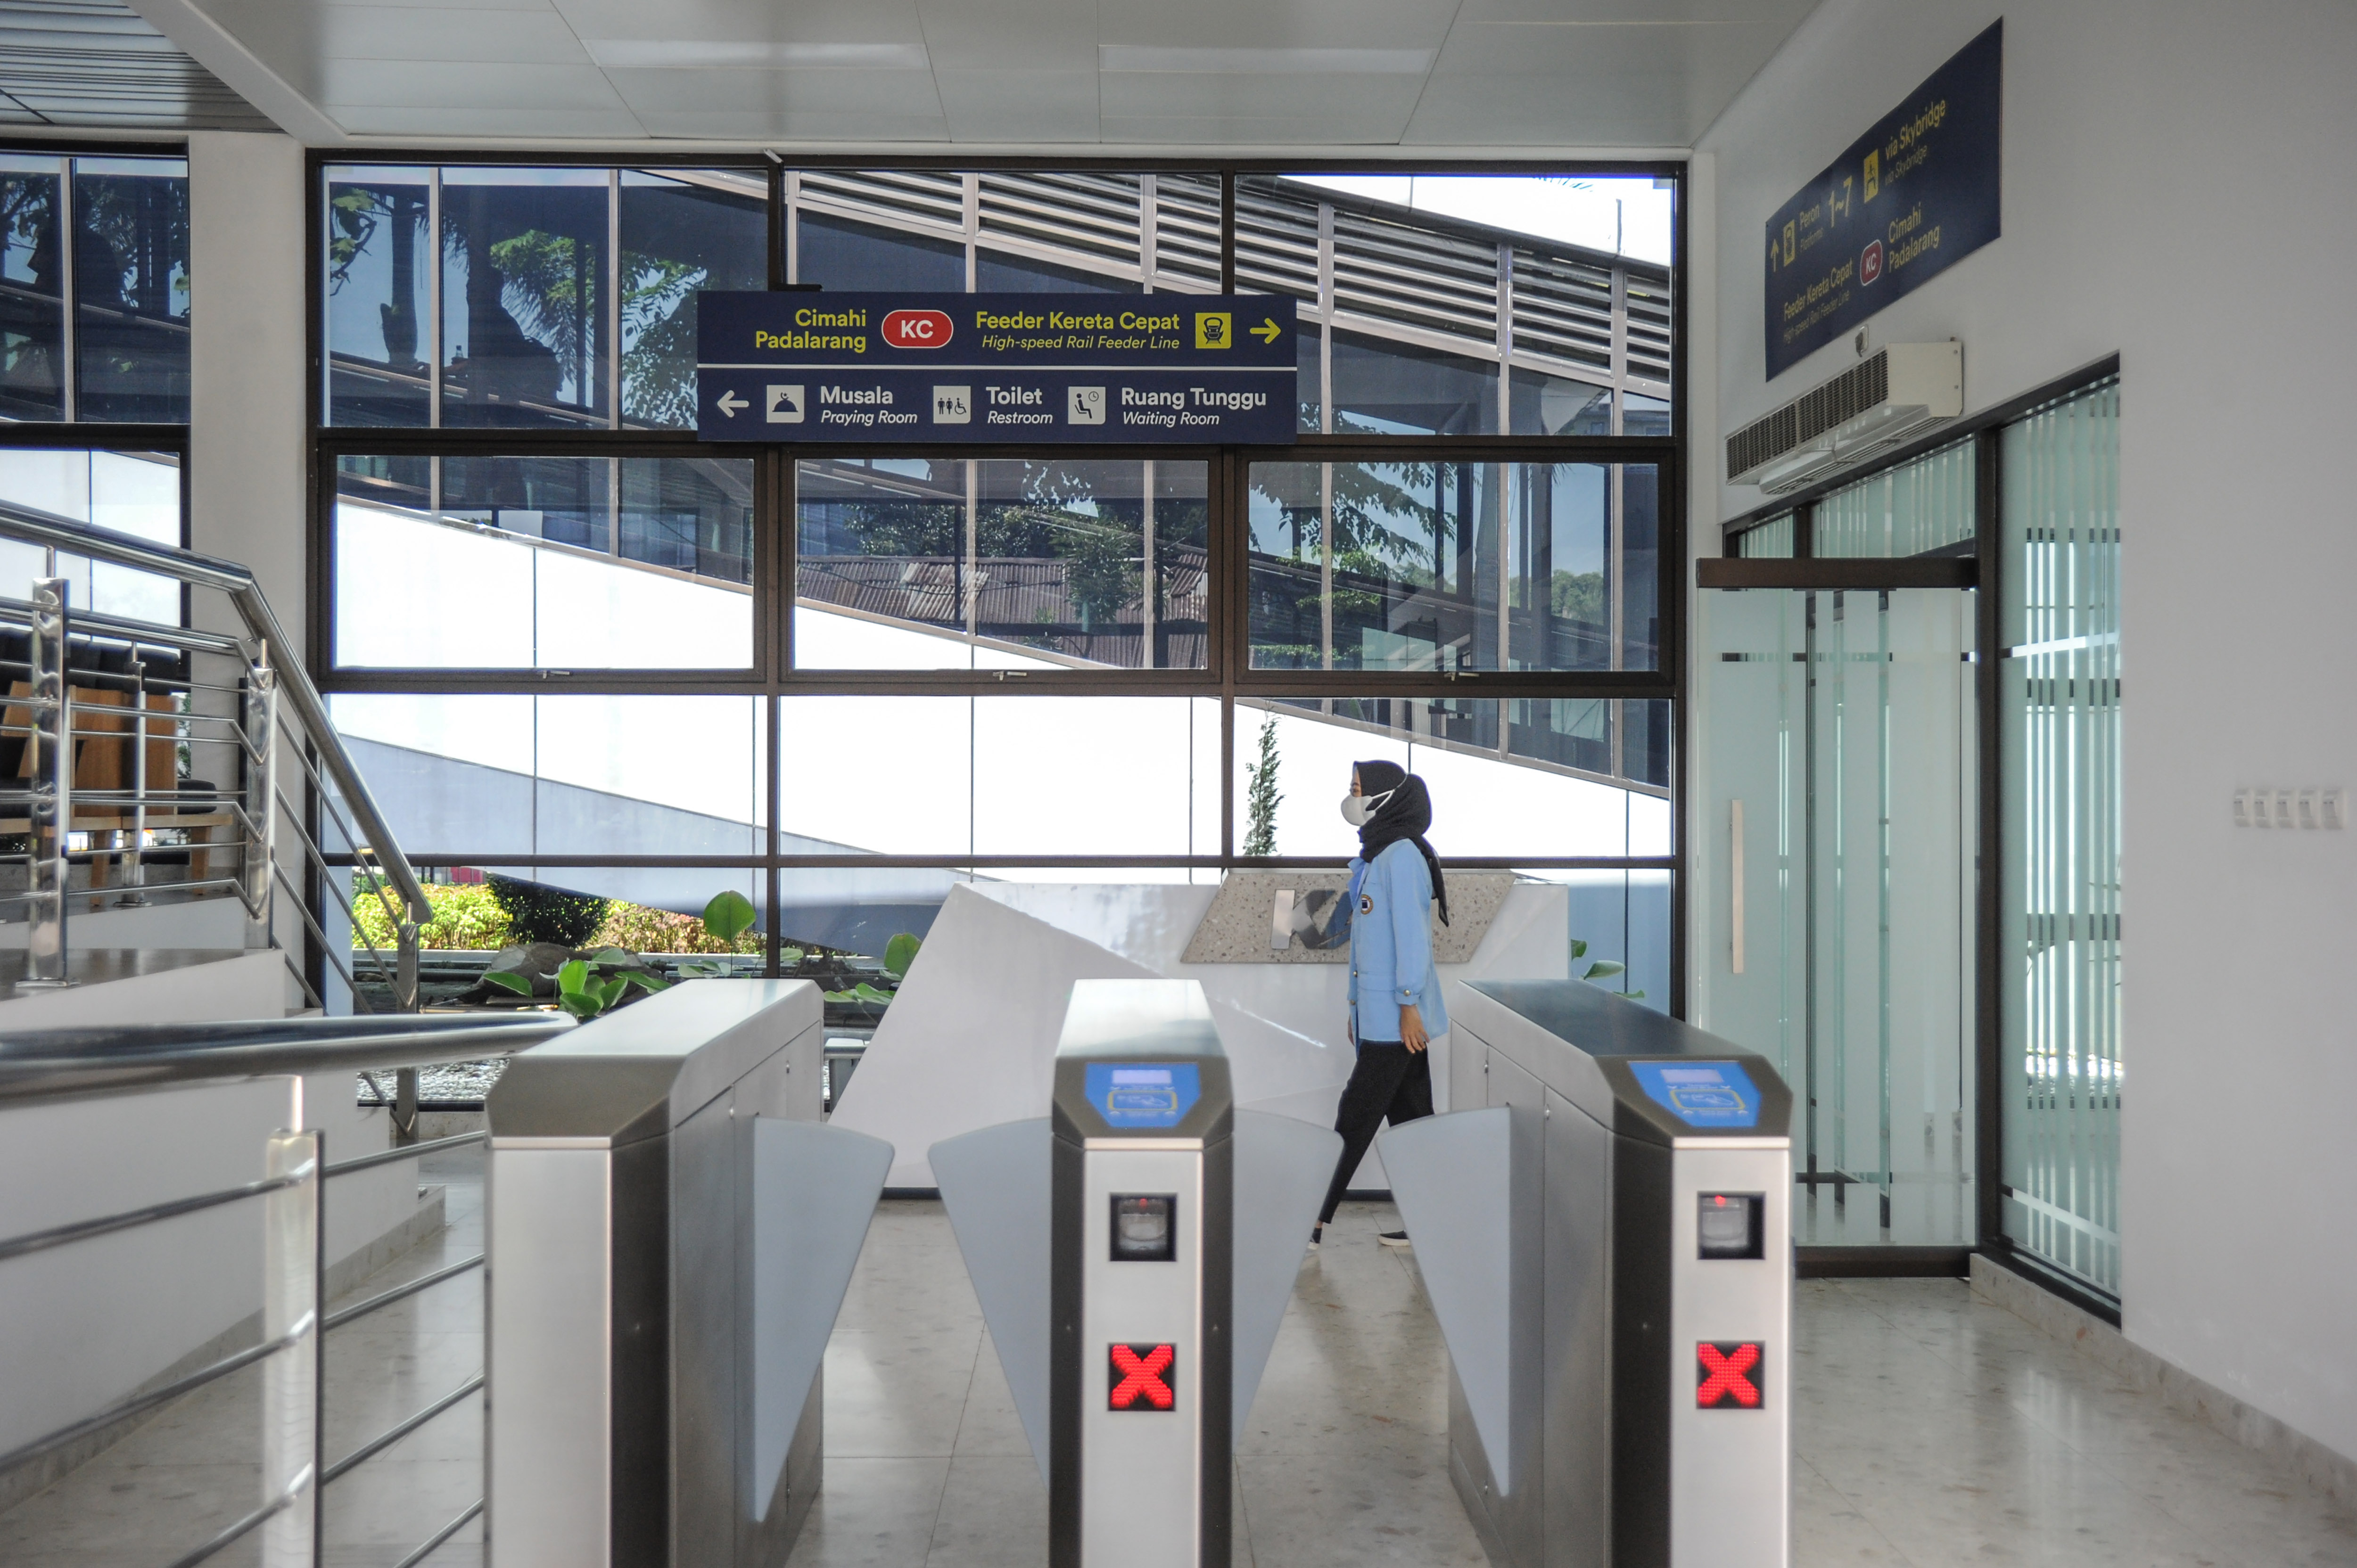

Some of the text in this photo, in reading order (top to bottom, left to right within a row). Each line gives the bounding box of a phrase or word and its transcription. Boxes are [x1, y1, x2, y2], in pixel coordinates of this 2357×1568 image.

[1886, 99, 1945, 160] via Skybridge
[1895, 145, 1927, 178] Skybridge
[1800, 204, 1820, 231] Peron
[1889, 201, 1921, 243] Cimahi
[1889, 225, 1940, 273] Padalarang
[1866, 253, 1876, 274] KC
[1784, 257, 1852, 322] Feeder Kereta Cepat
[796, 309, 866, 326] Cimahi
[976, 311, 1179, 333] Feeder Kereta Cepat
[901, 320, 933, 338] KC
[756, 331, 866, 353] Padalarang
[982, 336, 1179, 351] High-speed Rail Feeder Line
[820, 386, 892, 404] Musala
[986, 386, 1042, 404] Toilet
[1122, 388, 1266, 410] Ruang Tunggu
[821, 411, 917, 426] Praying Room
[988, 411, 1053, 424] Restroom
[1123, 412, 1220, 427] Waiting Room
